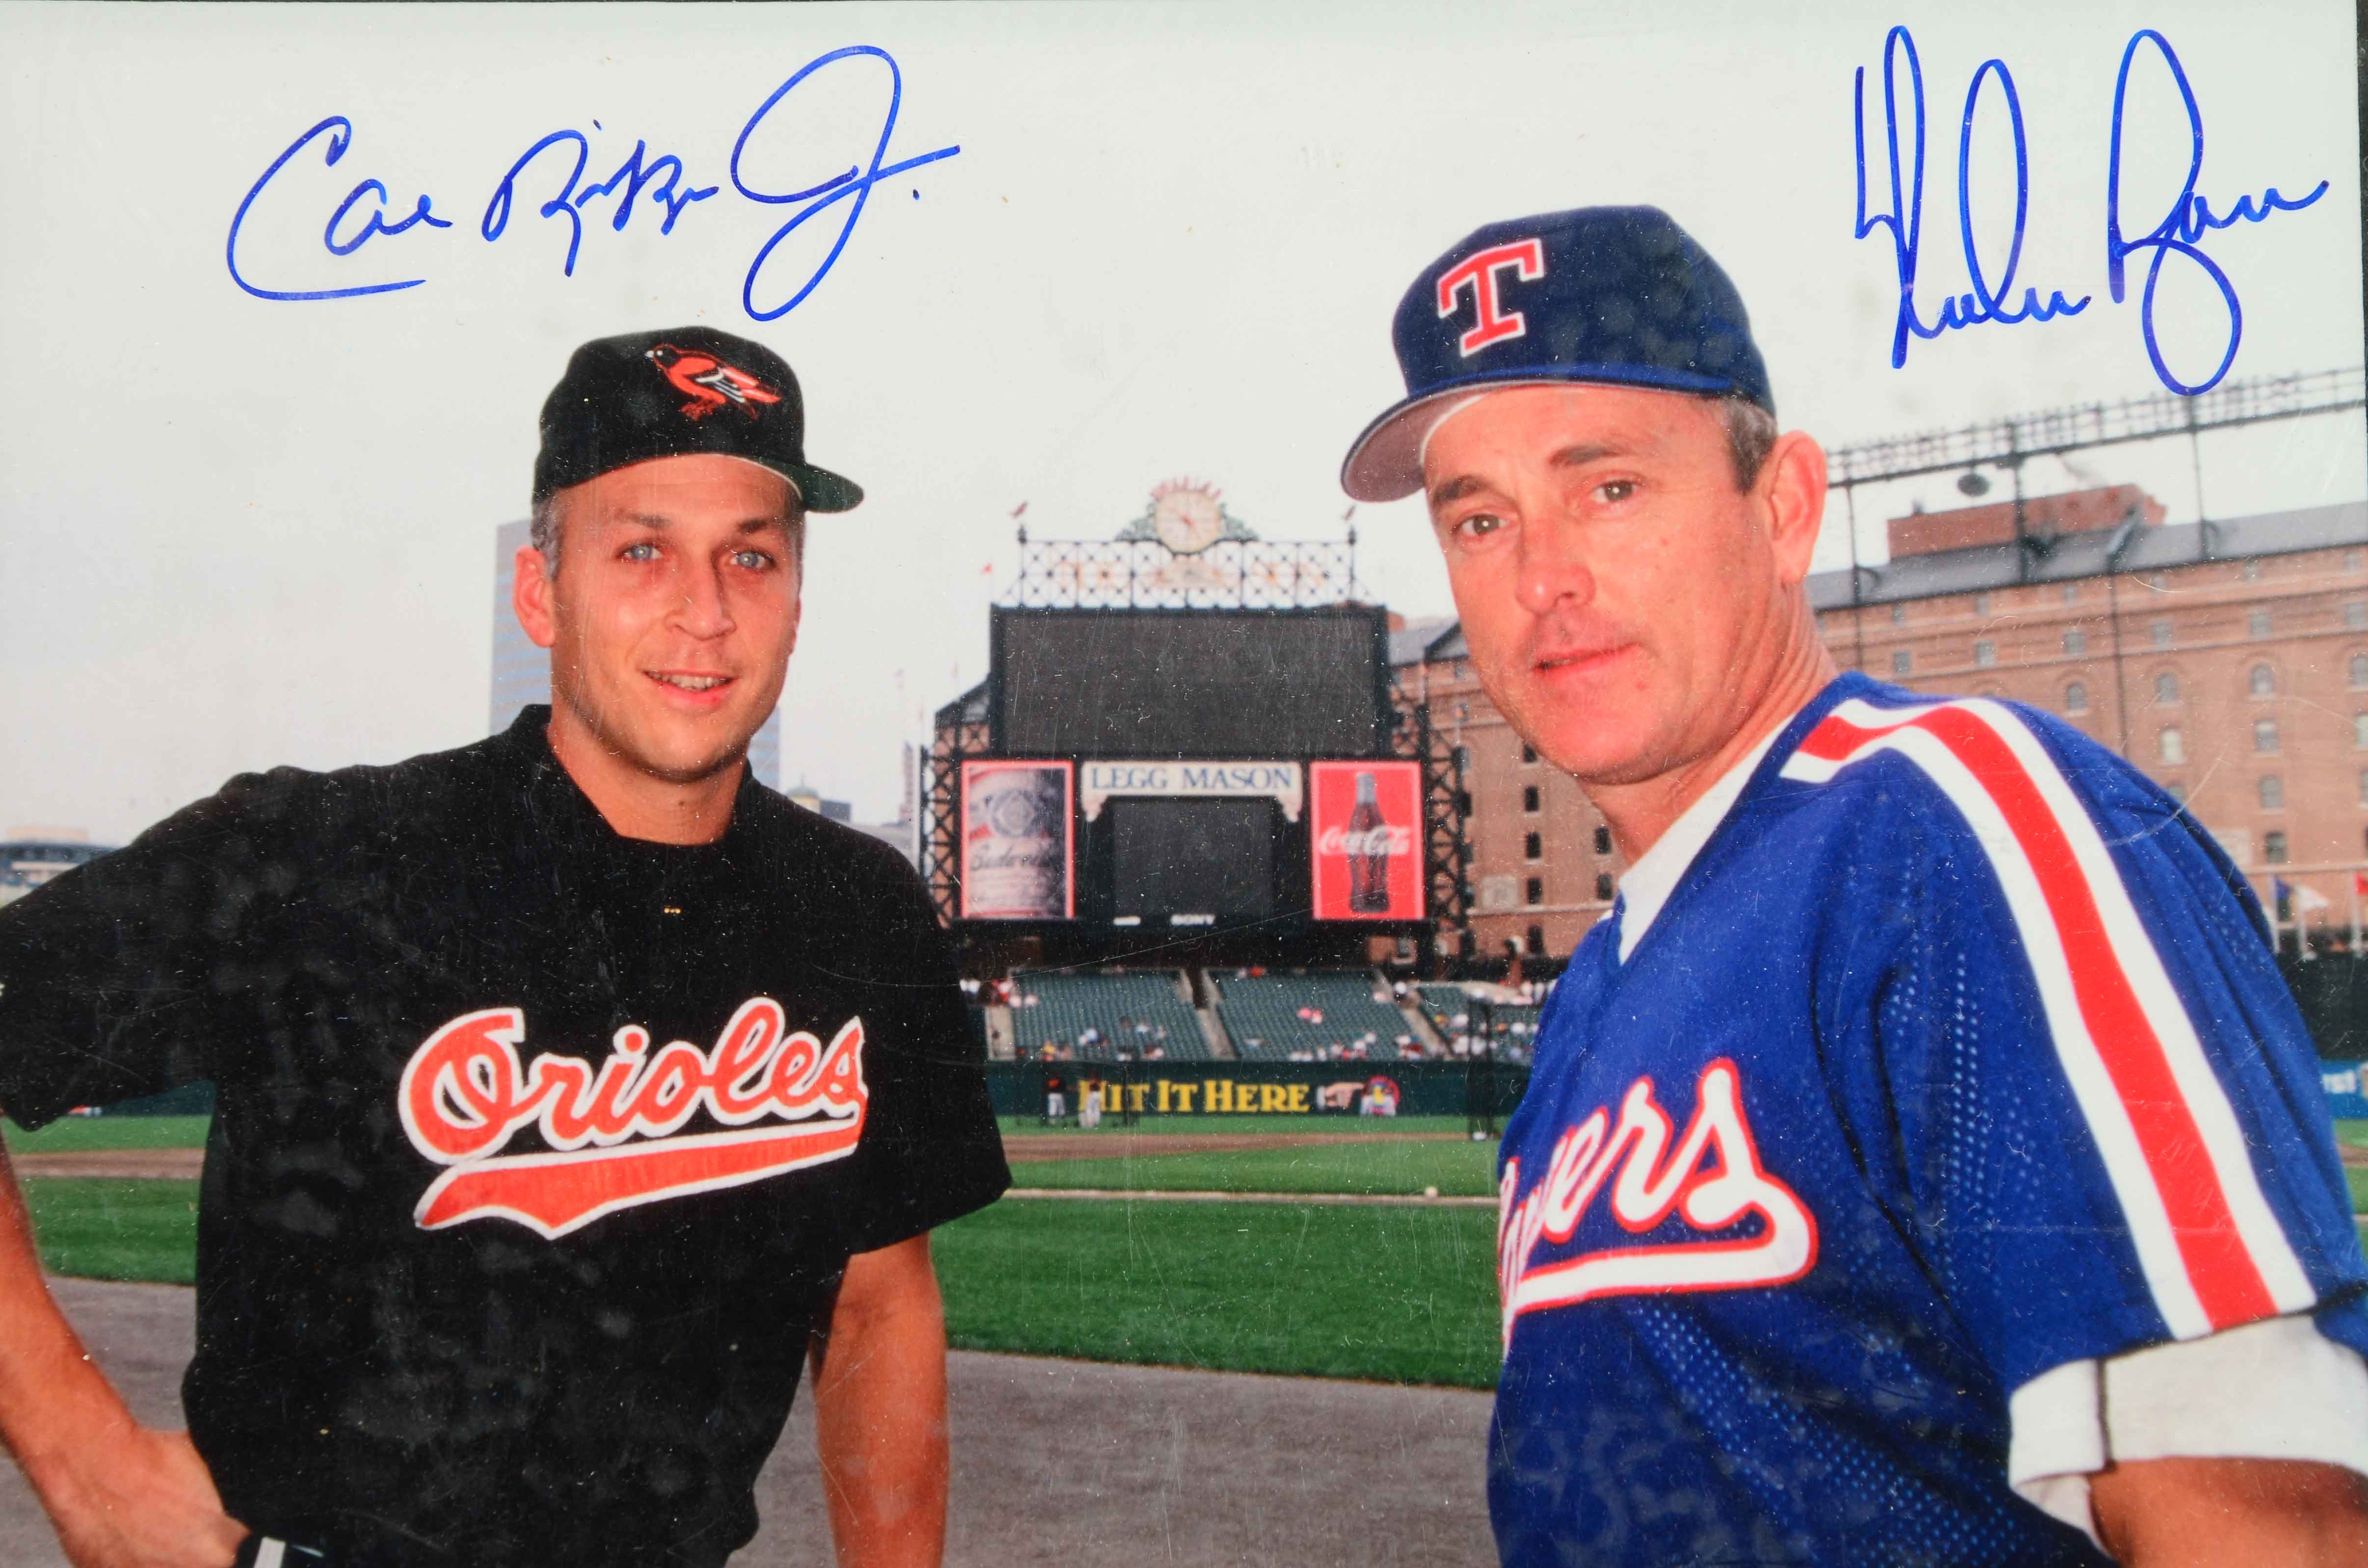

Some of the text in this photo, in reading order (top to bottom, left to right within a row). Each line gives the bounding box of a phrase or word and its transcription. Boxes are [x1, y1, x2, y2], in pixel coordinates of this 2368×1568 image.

[1437, 238, 1544, 358] T
[1091, 767, 1292, 789] LEGG MASON
[399, 997, 868, 1165] Orioles
